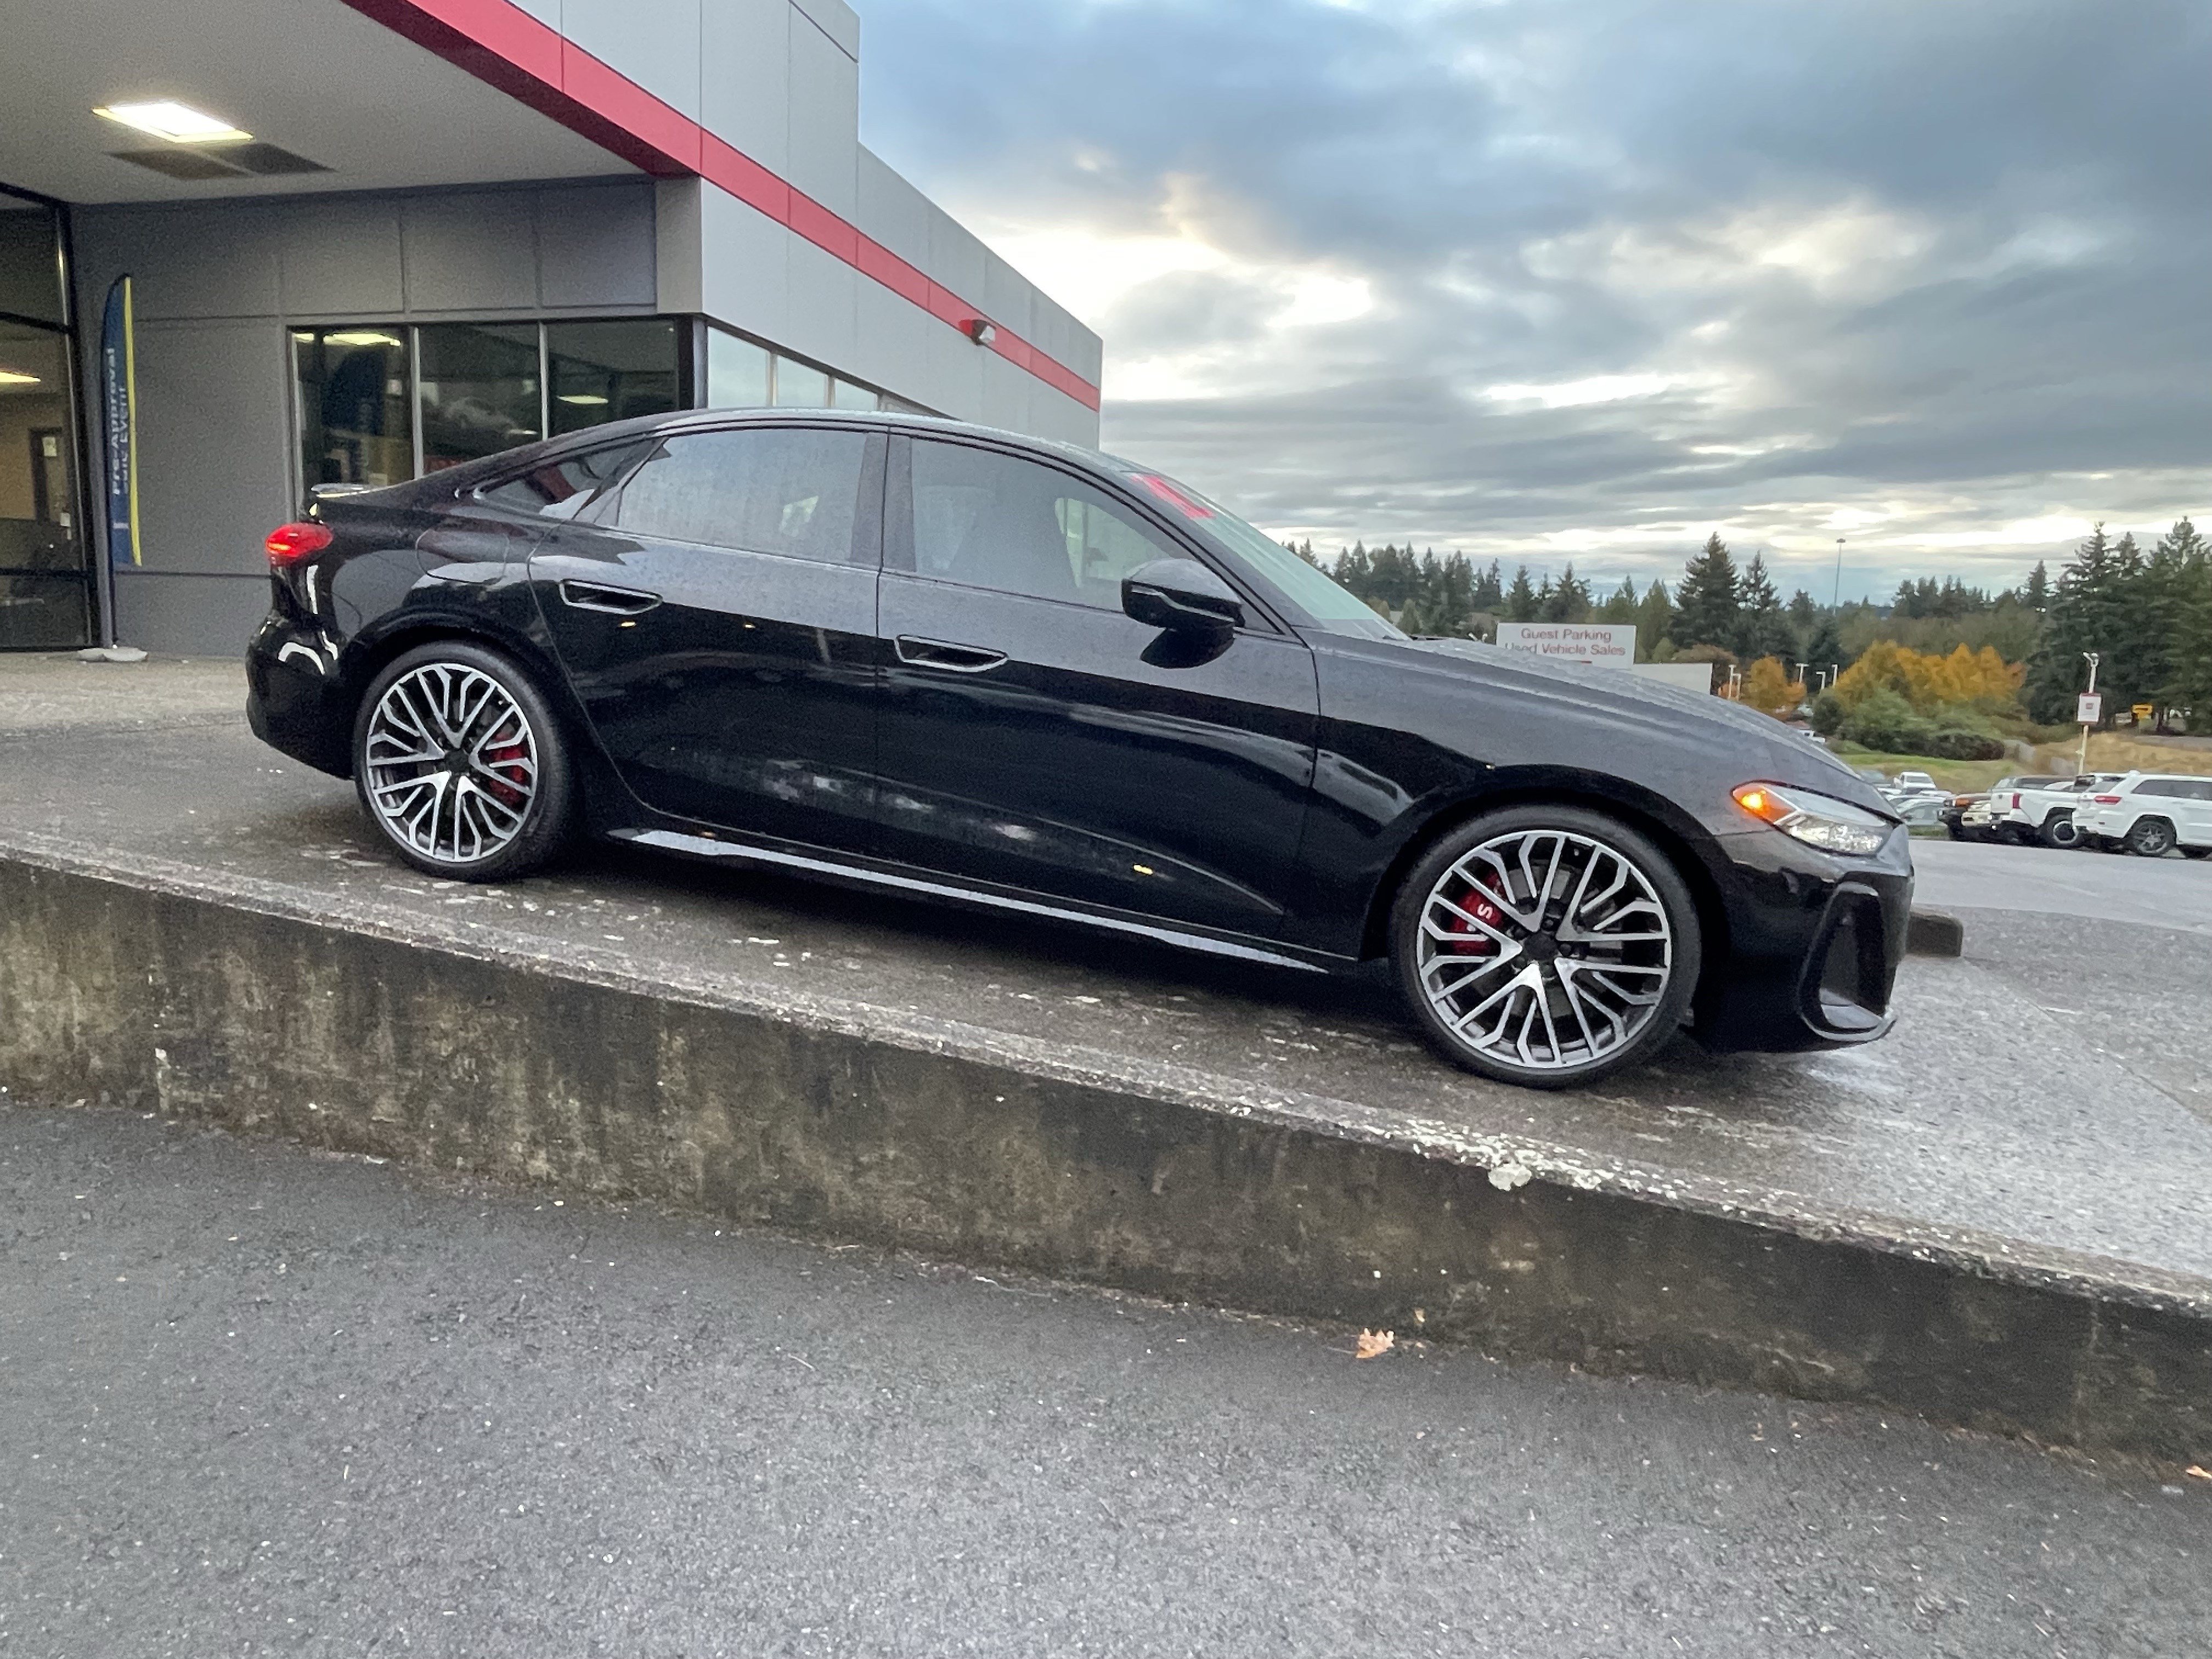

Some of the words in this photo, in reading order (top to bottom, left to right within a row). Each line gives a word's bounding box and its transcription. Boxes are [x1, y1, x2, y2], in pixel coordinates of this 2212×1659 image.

[108, 348, 120, 495] Pre-Approval
[119, 386, 128, 443] Event
[1521, 628, 1558, 640] Guest
[1563, 629, 1611, 644] Parking
[1505, 642, 1538, 653] Used
[1542, 643, 1587, 655] Vehicle
[1590, 644, 1626, 656] Sales
[1477, 903, 1493, 921] S
